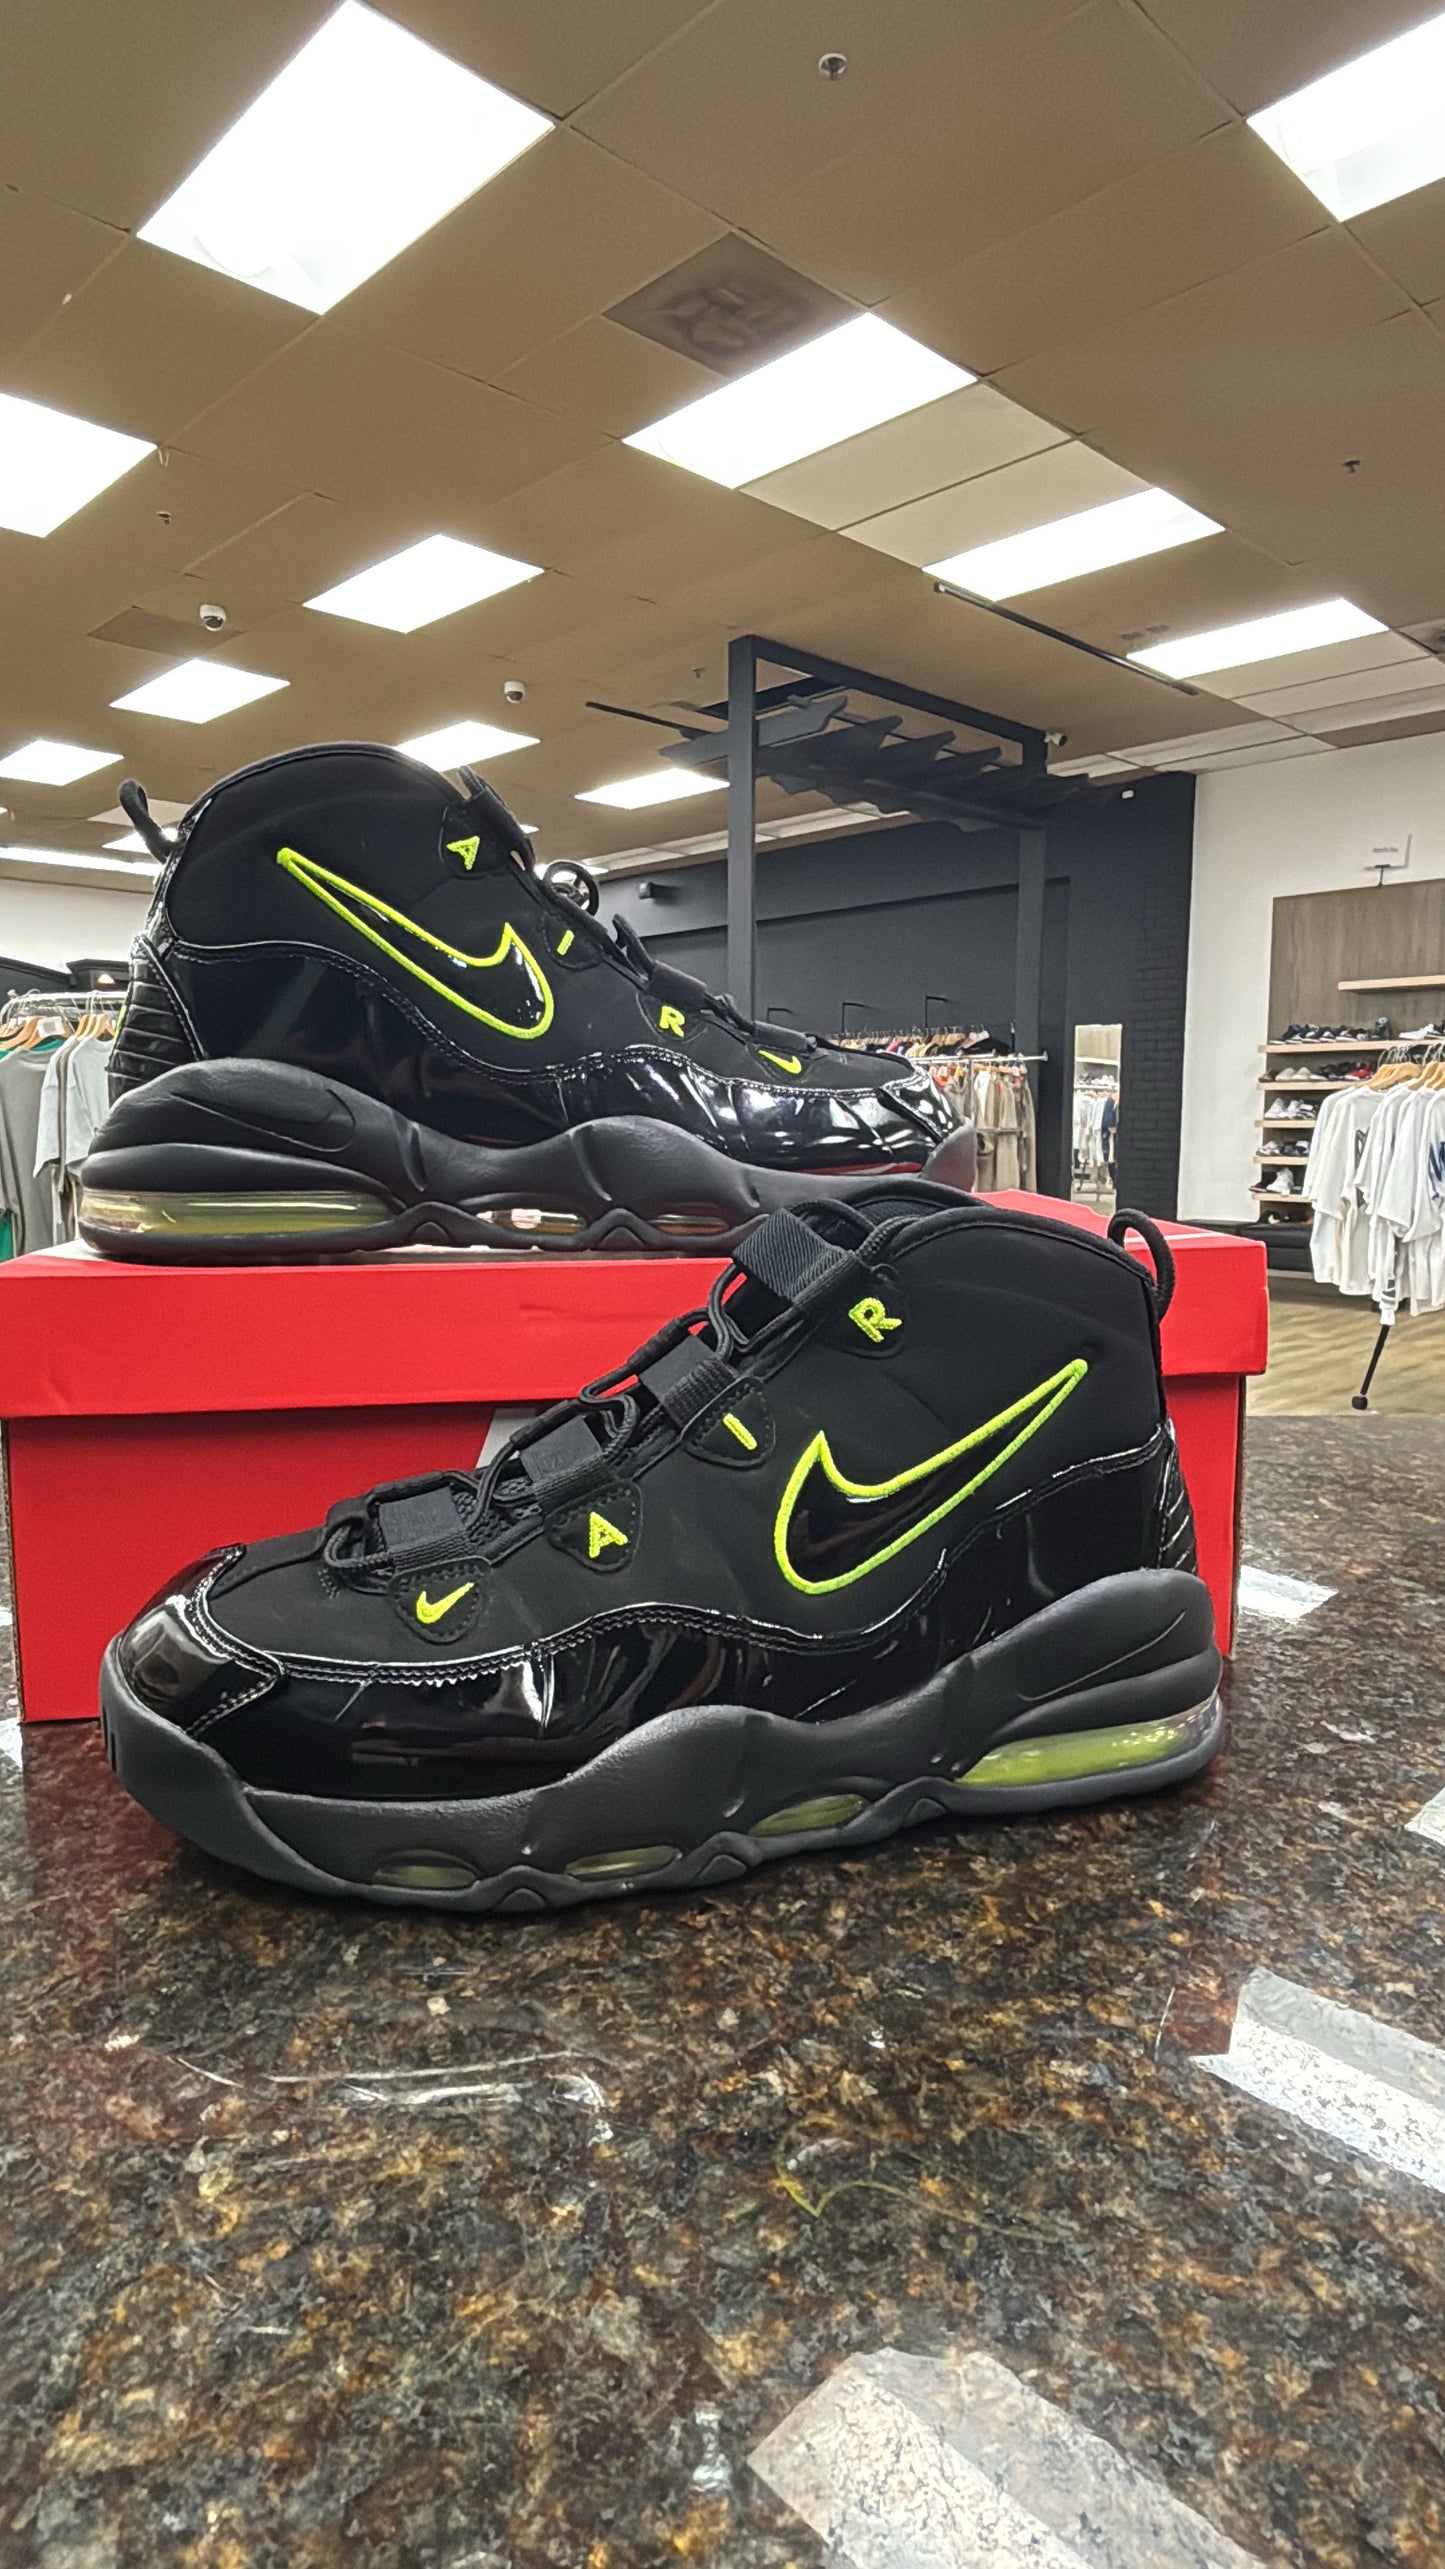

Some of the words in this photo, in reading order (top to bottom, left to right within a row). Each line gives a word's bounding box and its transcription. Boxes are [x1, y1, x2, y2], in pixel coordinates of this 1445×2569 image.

[659, 1006, 685, 1038] R
[589, 1512, 627, 1559] A
[849, 1297, 902, 1342] R
